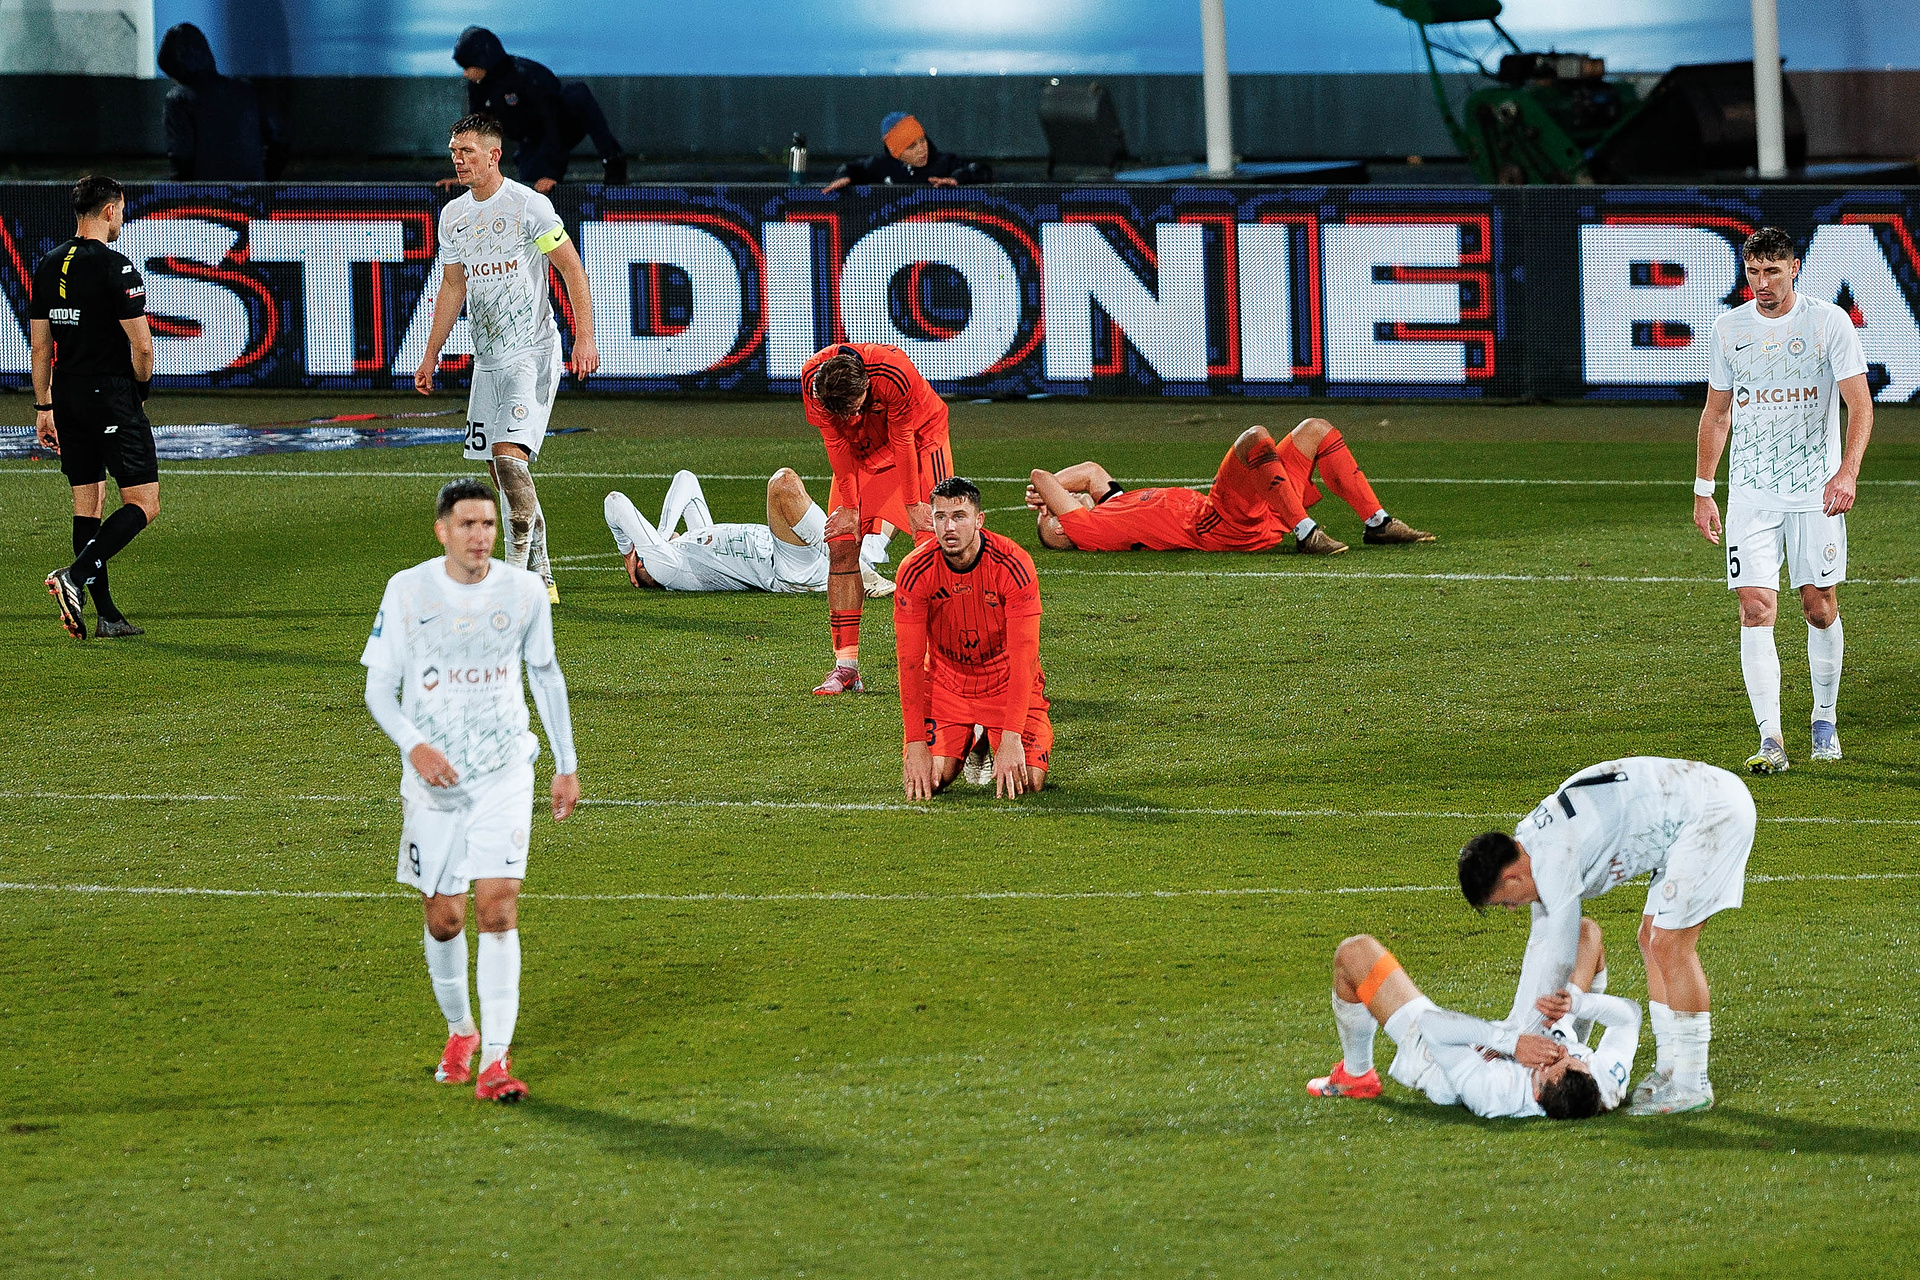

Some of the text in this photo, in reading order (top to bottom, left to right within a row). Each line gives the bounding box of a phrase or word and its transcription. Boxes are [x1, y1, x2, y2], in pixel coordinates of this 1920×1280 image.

[471, 259, 518, 277] KGHM
[1755, 386, 1818, 404] KGHM
[1729, 545, 1741, 578] 5
[448, 666, 507, 684] KGHM
[924, 717, 937, 746] 3
